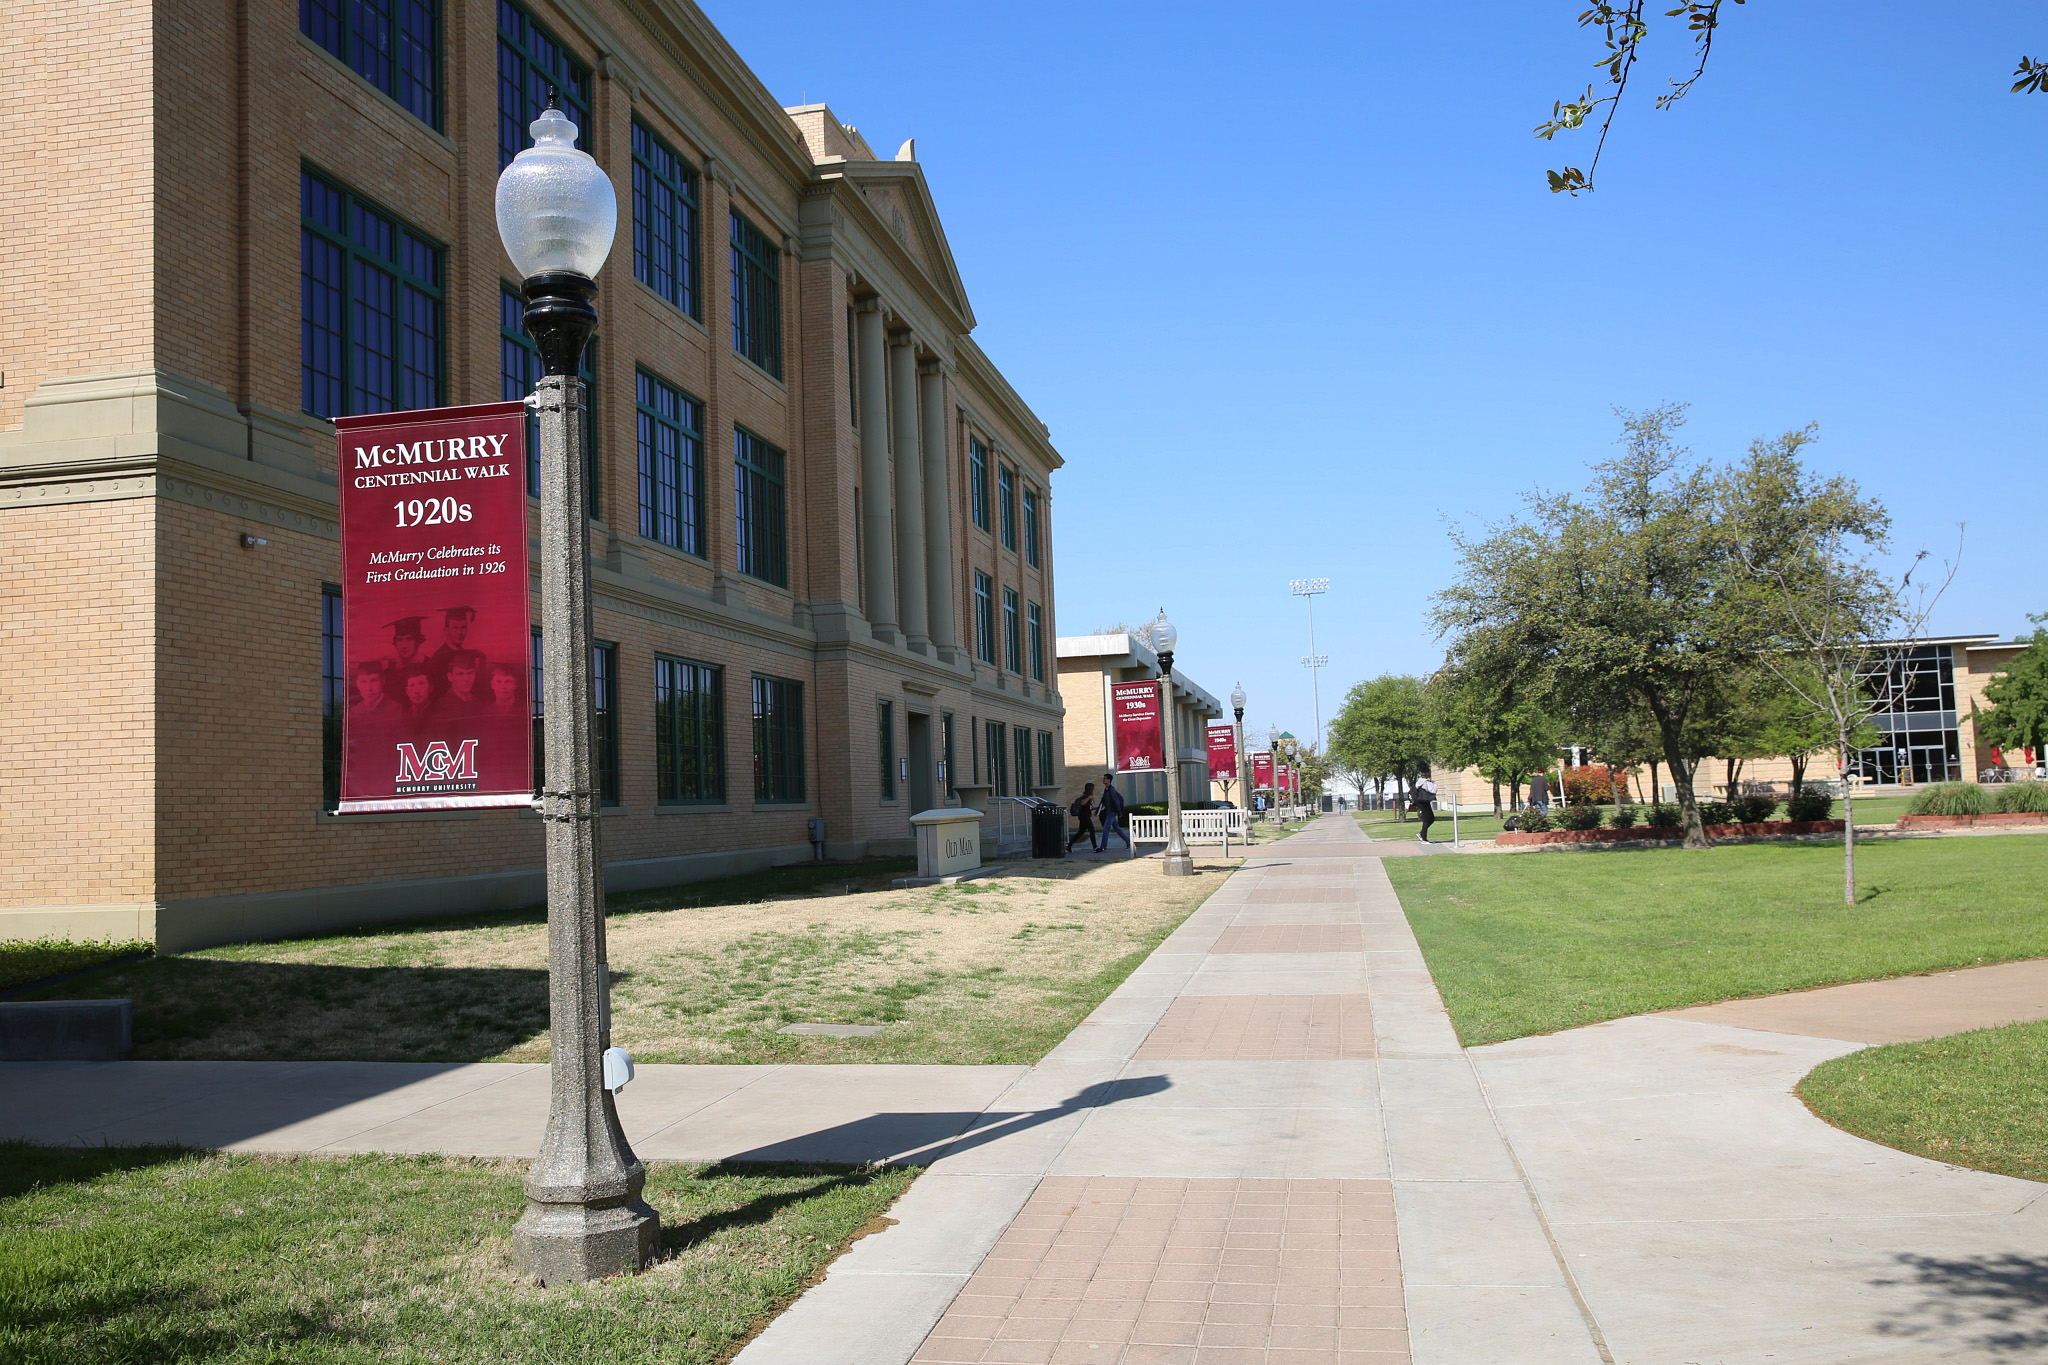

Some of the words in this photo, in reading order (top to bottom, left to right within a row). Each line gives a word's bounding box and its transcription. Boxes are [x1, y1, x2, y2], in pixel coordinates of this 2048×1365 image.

[354, 433, 509, 469] McMURRY
[354, 468, 462, 489] CENTENNIAL
[464, 463, 511, 479] WALK
[393, 496, 473, 528] 1920s
[369, 550, 424, 565] McMurry
[427, 544, 485, 560] Celebrates
[487, 543, 501, 555] its
[366, 570, 392, 583] First
[394, 565, 459, 581] Graduation
[463, 564, 474, 576] in
[478, 561, 507, 575] 1926
[1116, 687, 1154, 696] McMURRY
[1126, 701, 1146, 709] 1930s
[396, 785, 430, 793] MCMURRY
[433, 783, 476, 791] UNIVERSITY
